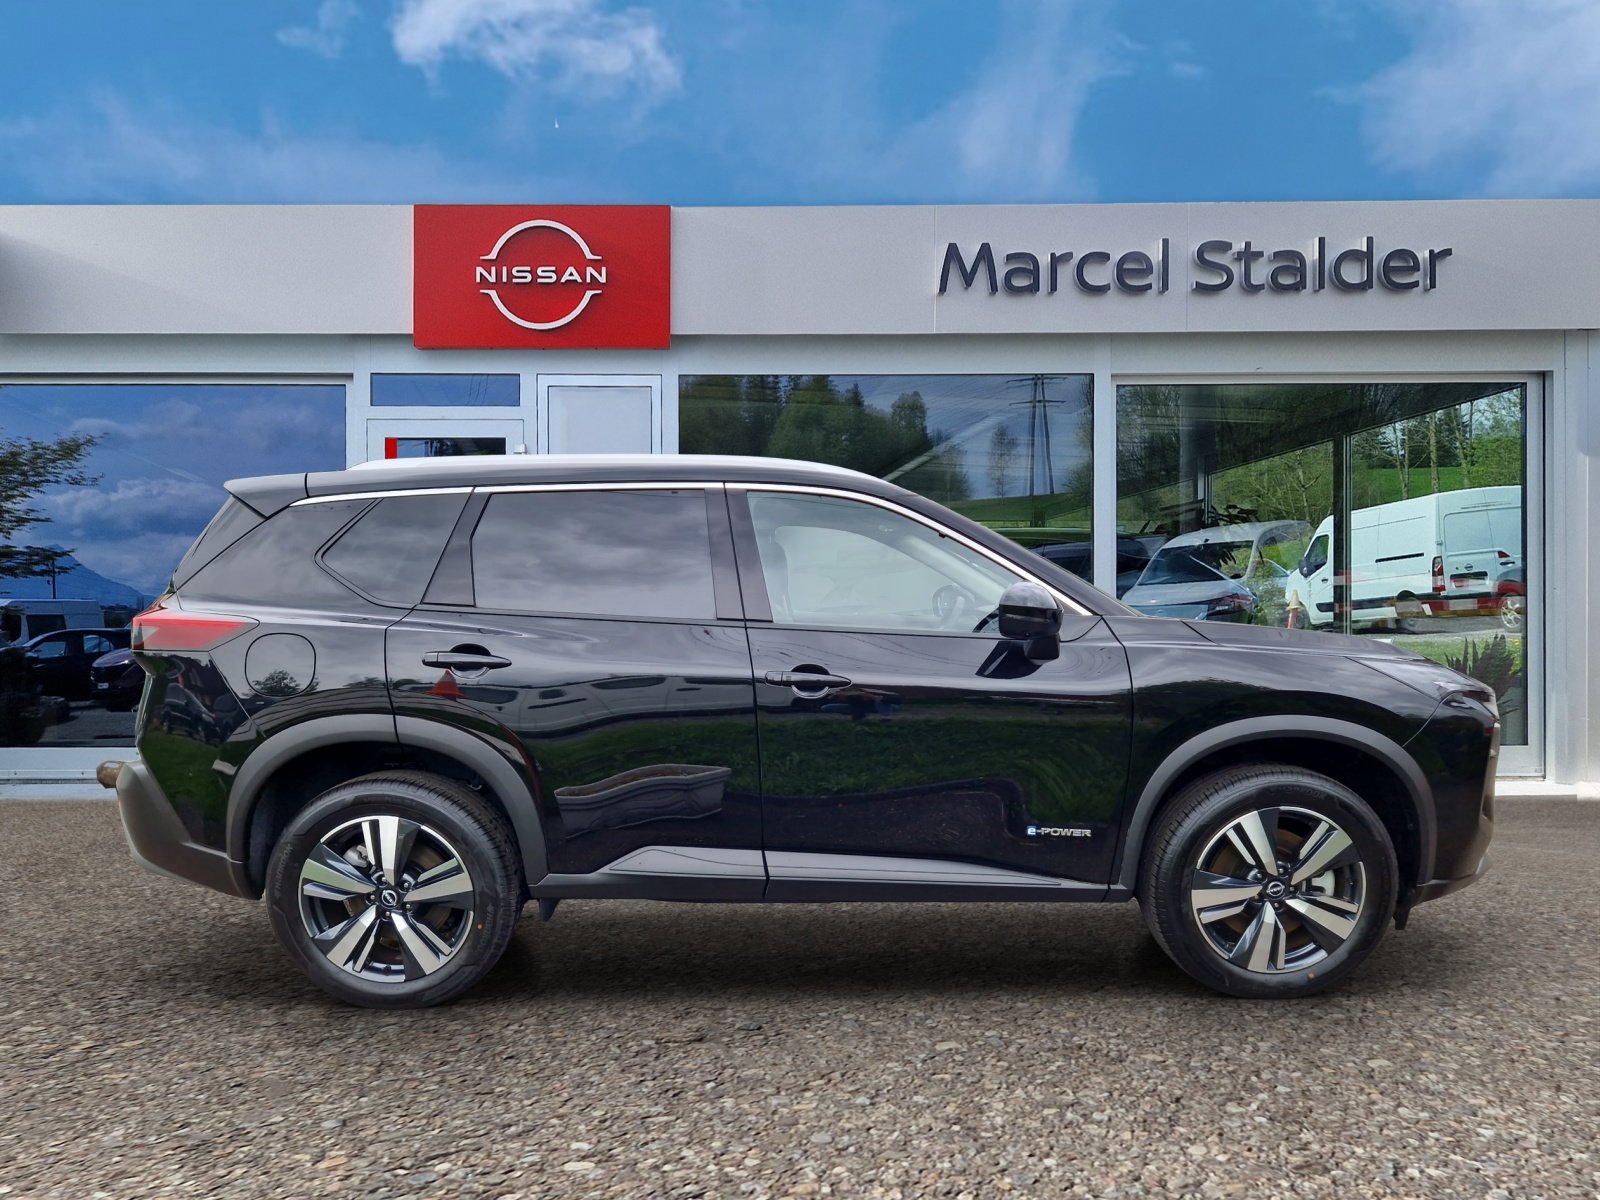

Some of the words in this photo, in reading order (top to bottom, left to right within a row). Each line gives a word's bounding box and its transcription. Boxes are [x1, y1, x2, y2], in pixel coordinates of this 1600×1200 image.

[475, 265, 608, 284] NISSAN
[937, 238, 1170, 296] Marcel
[1191, 236, 1453, 294] Stalder
[1026, 825, 1092, 838] e-POWER
